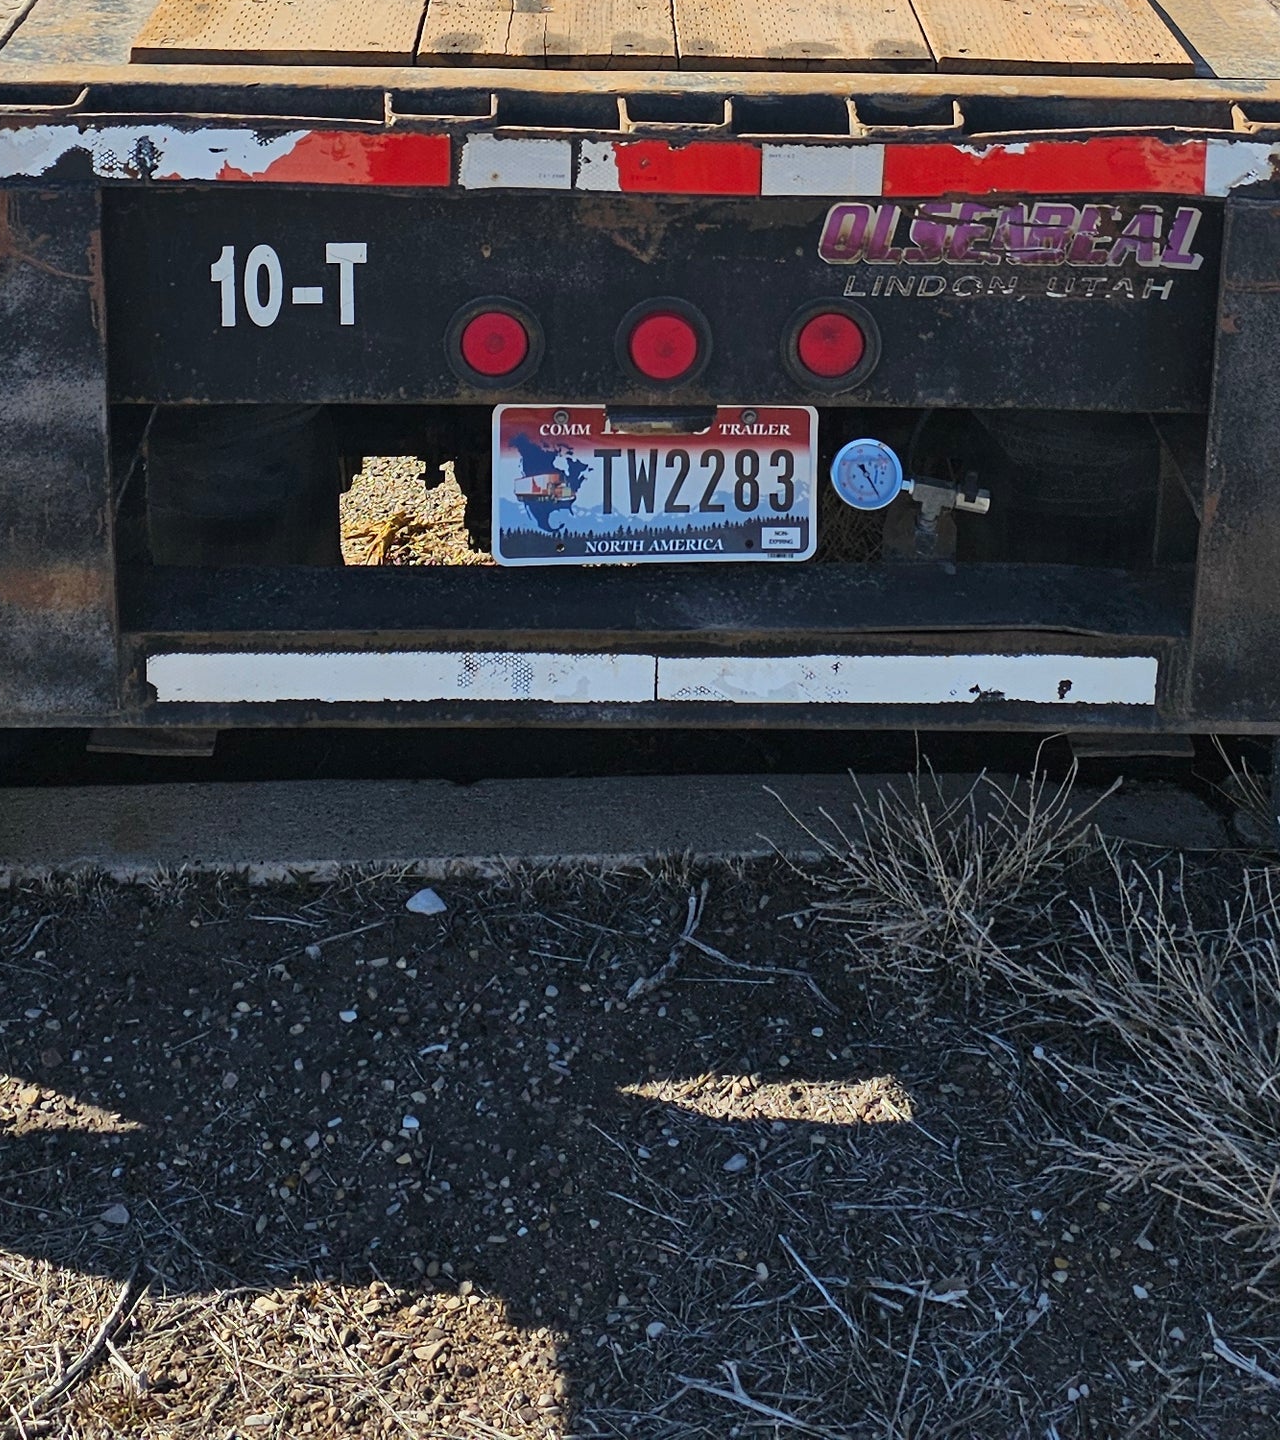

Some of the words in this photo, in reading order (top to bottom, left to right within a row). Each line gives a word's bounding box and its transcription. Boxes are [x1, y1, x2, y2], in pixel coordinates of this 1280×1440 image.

[210, 242, 367, 327] 10-T
[1046, 277, 1173, 300] UTAH
[540, 424, 591, 435] COMM
[719, 424, 791, 436] TRAILER
[594, 448, 795, 514] TW2283
[585, 540, 644, 553] NORTH
[648, 539, 723, 551] AMERICA
